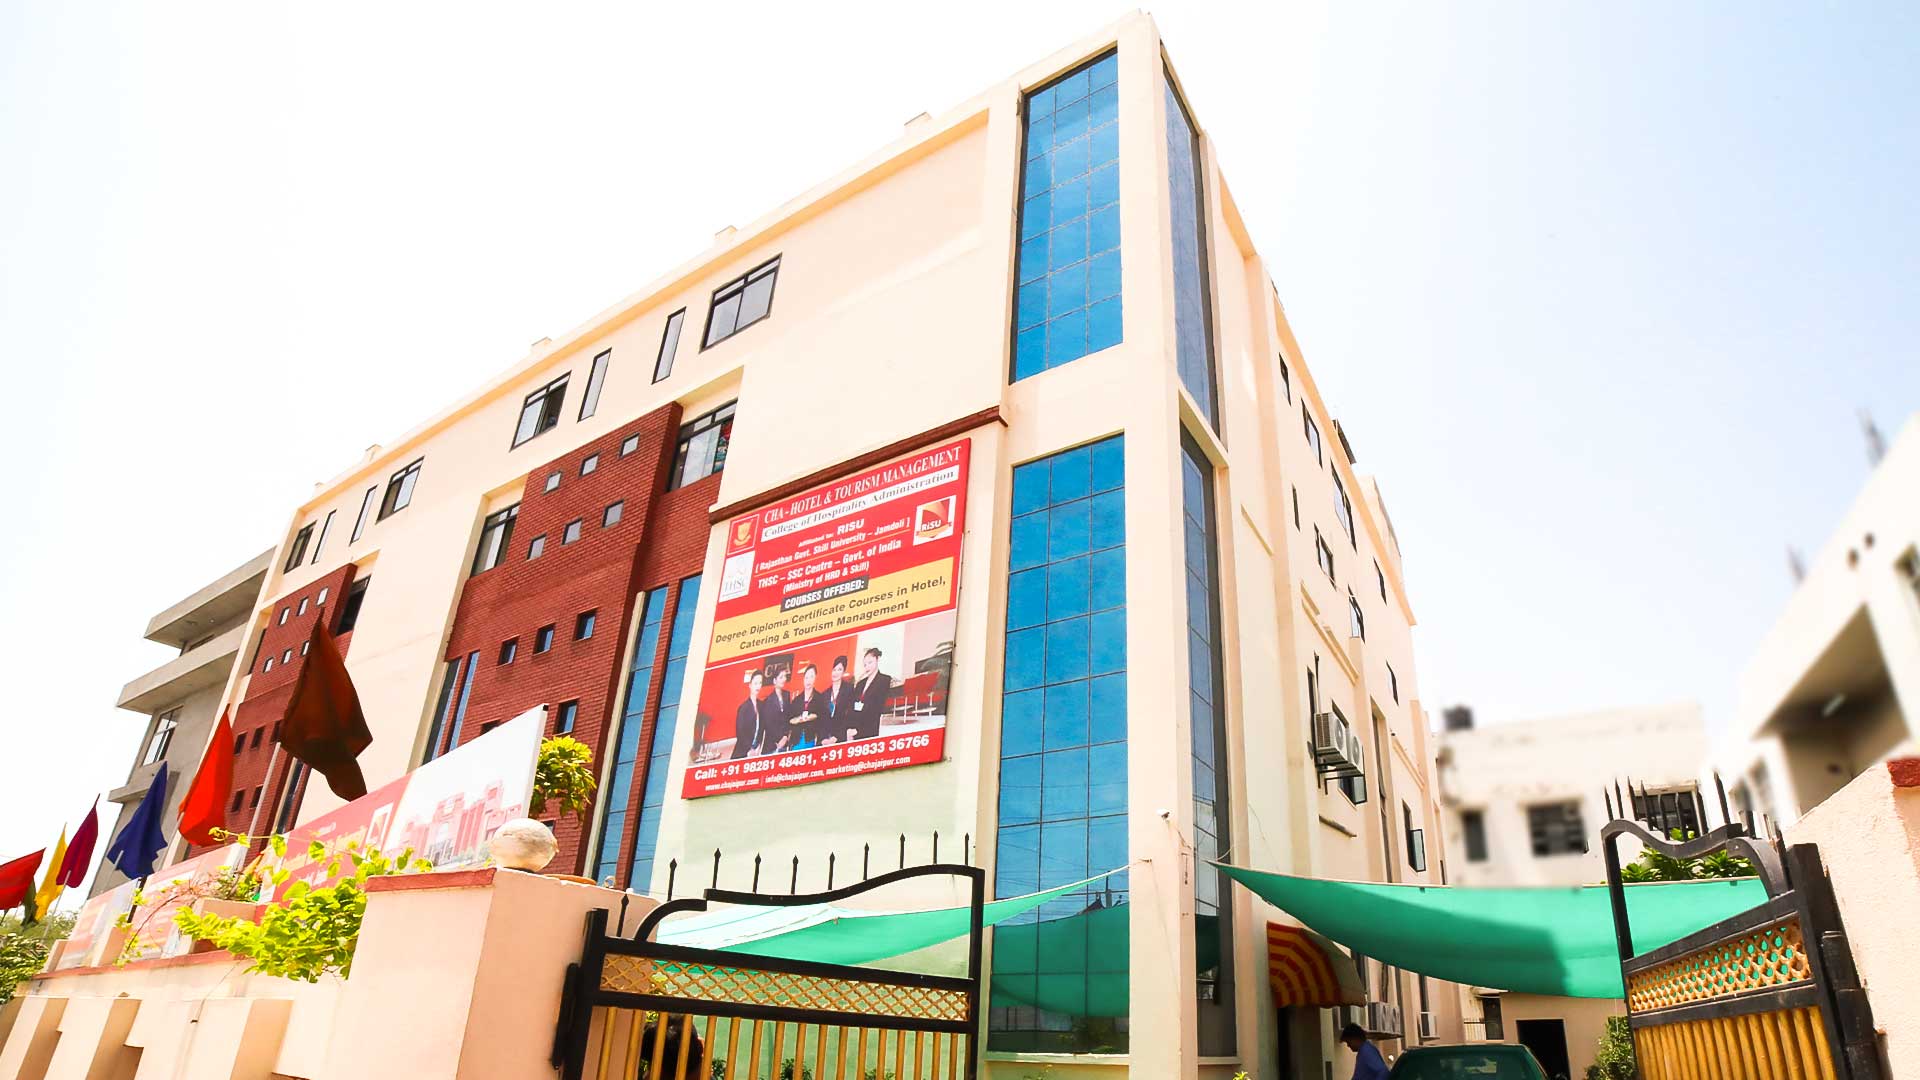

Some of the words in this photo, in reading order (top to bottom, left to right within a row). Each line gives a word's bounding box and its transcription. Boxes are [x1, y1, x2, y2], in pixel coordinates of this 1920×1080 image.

[823, 491, 832, 505] &
[834, 474, 880, 501] TOURISM
[883, 446, 962, 483] MANAGEMENT
[764, 520, 799, 538] College
[801, 515, 812, 526] of
[812, 499, 868, 523] Hospitality
[871, 471, 955, 504] Administration
[837, 519, 865, 535] RISU
[758, 574, 779, 589] THSC
[787, 567, 804, 581] SSC
[805, 560, 833, 577] Centre
[843, 551, 865, 564] Govt.
[869, 546, 878, 557] of
[879, 538, 902, 555] India
[760, 554, 793, 571] Rajasthan
[794, 548, 812, 560] Govt.
[813, 541, 829, 555] Skill
[831, 532, 865, 554] University
[875, 521, 904, 536] Jamdoli
[783, 576, 813, 594] (Ministry
[815, 574, 823, 585] of
[825, 569, 841, 582] HRD
[842, 566, 849, 577] &
[850, 561, 869, 577] Skill)
[784, 591, 822, 609] COURSES
[823, 579, 865, 600] OFFERED:
[715, 628, 748, 644] Degree
[849, 591, 893, 610] Courses
[897, 586, 908, 596] in
[911, 576, 946, 594] Hotel,
[739, 631, 780, 651] Catering
[783, 630, 790, 640] &
[793, 619, 834, 636] Tourism
[836, 600, 909, 626] Management
[694, 768, 717, 781] Call:
[721, 763, 740, 776] +91
[743, 758, 776, 774] 98281
[778, 753, 817, 768] 48481,
[820, 749, 843, 763] +91
[847, 742, 885, 758] 99833
[888, 734, 930, 752] 36766
[764, 768, 825, 784] info@chajaipur.com,
[825, 755, 911, 777] marketing@chajaipur.com
